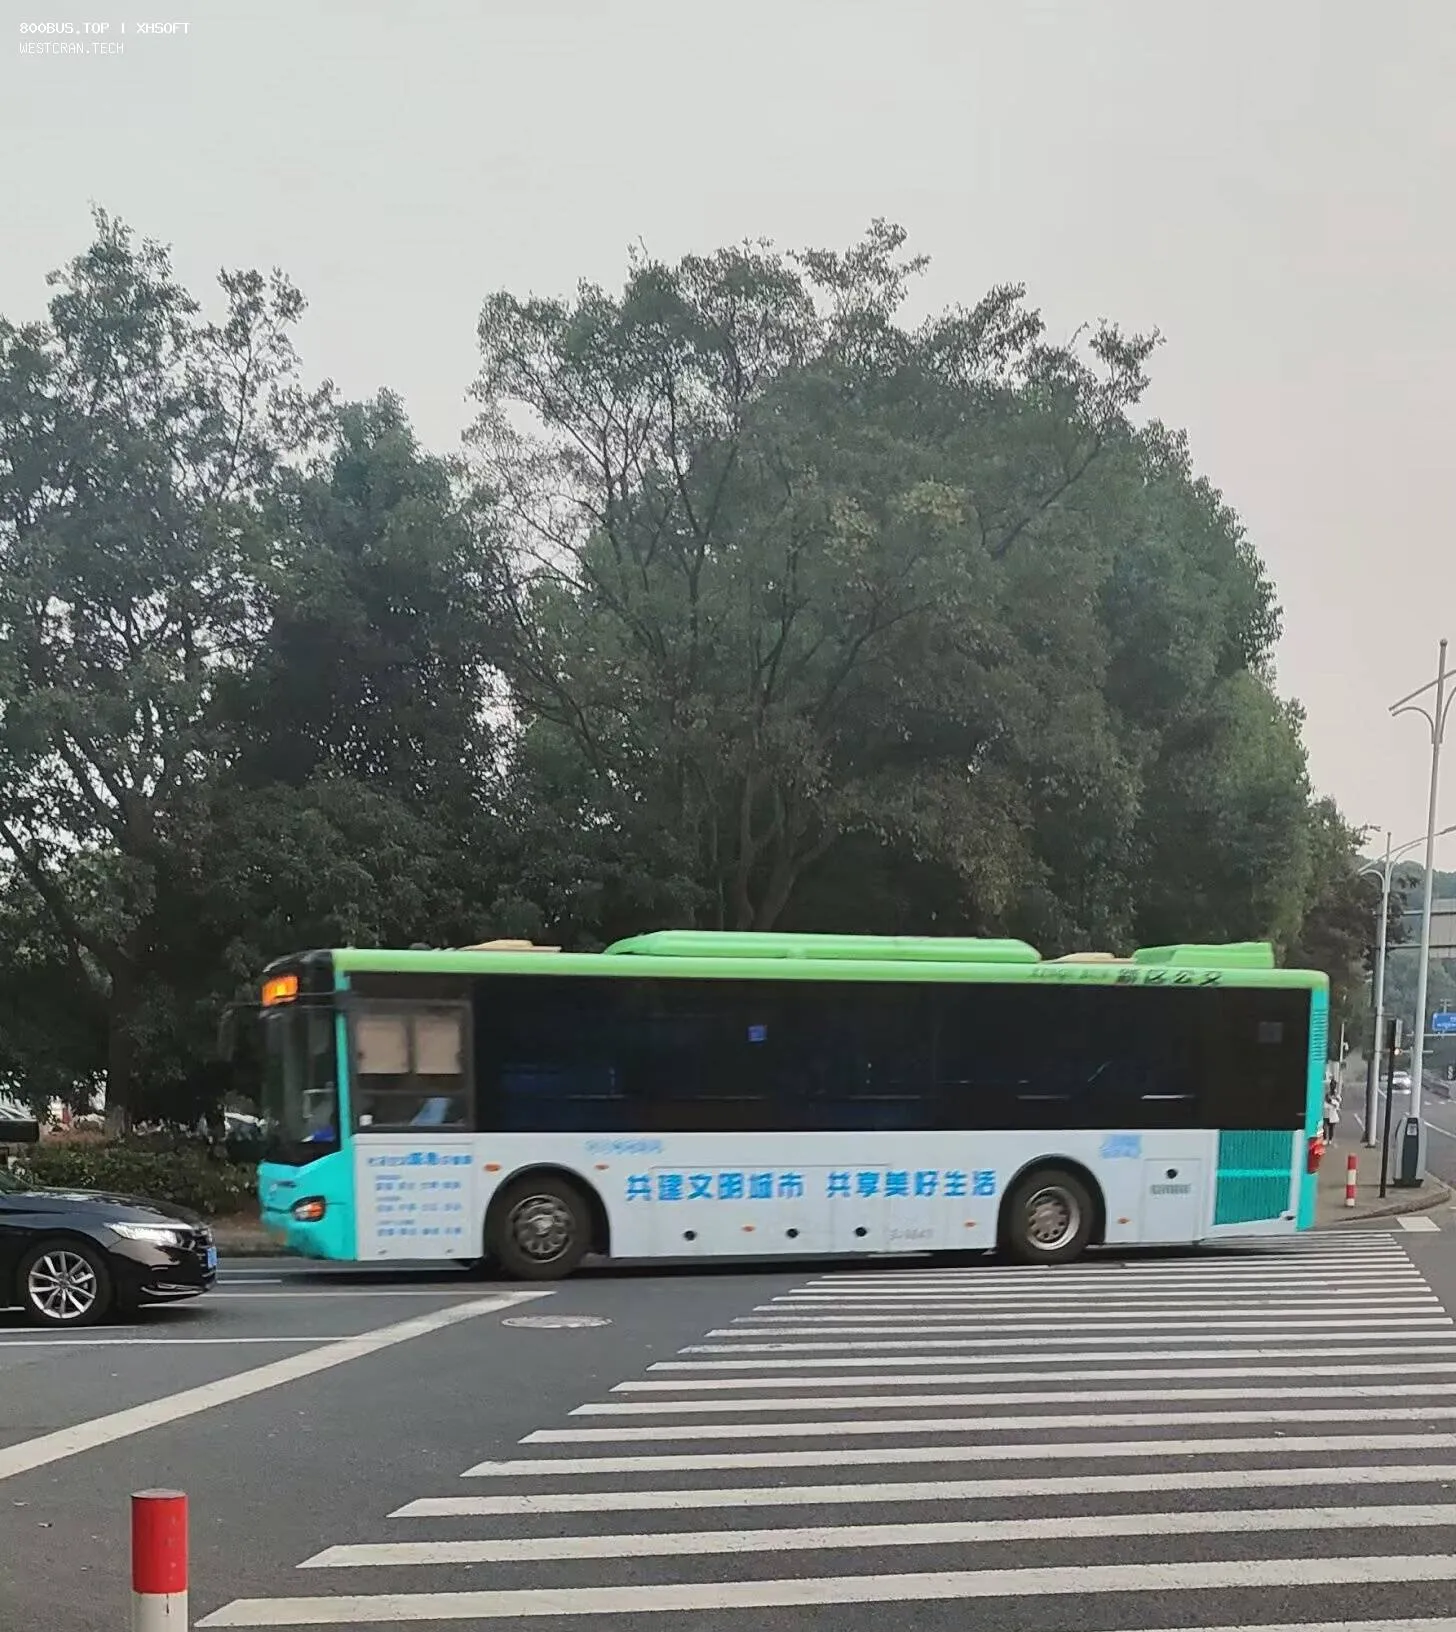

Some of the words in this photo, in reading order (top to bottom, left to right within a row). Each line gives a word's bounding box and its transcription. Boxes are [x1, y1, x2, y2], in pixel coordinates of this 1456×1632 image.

[626, 1172, 804, 1200] 共建文明城市
[827, 1170, 996, 1198] 共享美好生活
